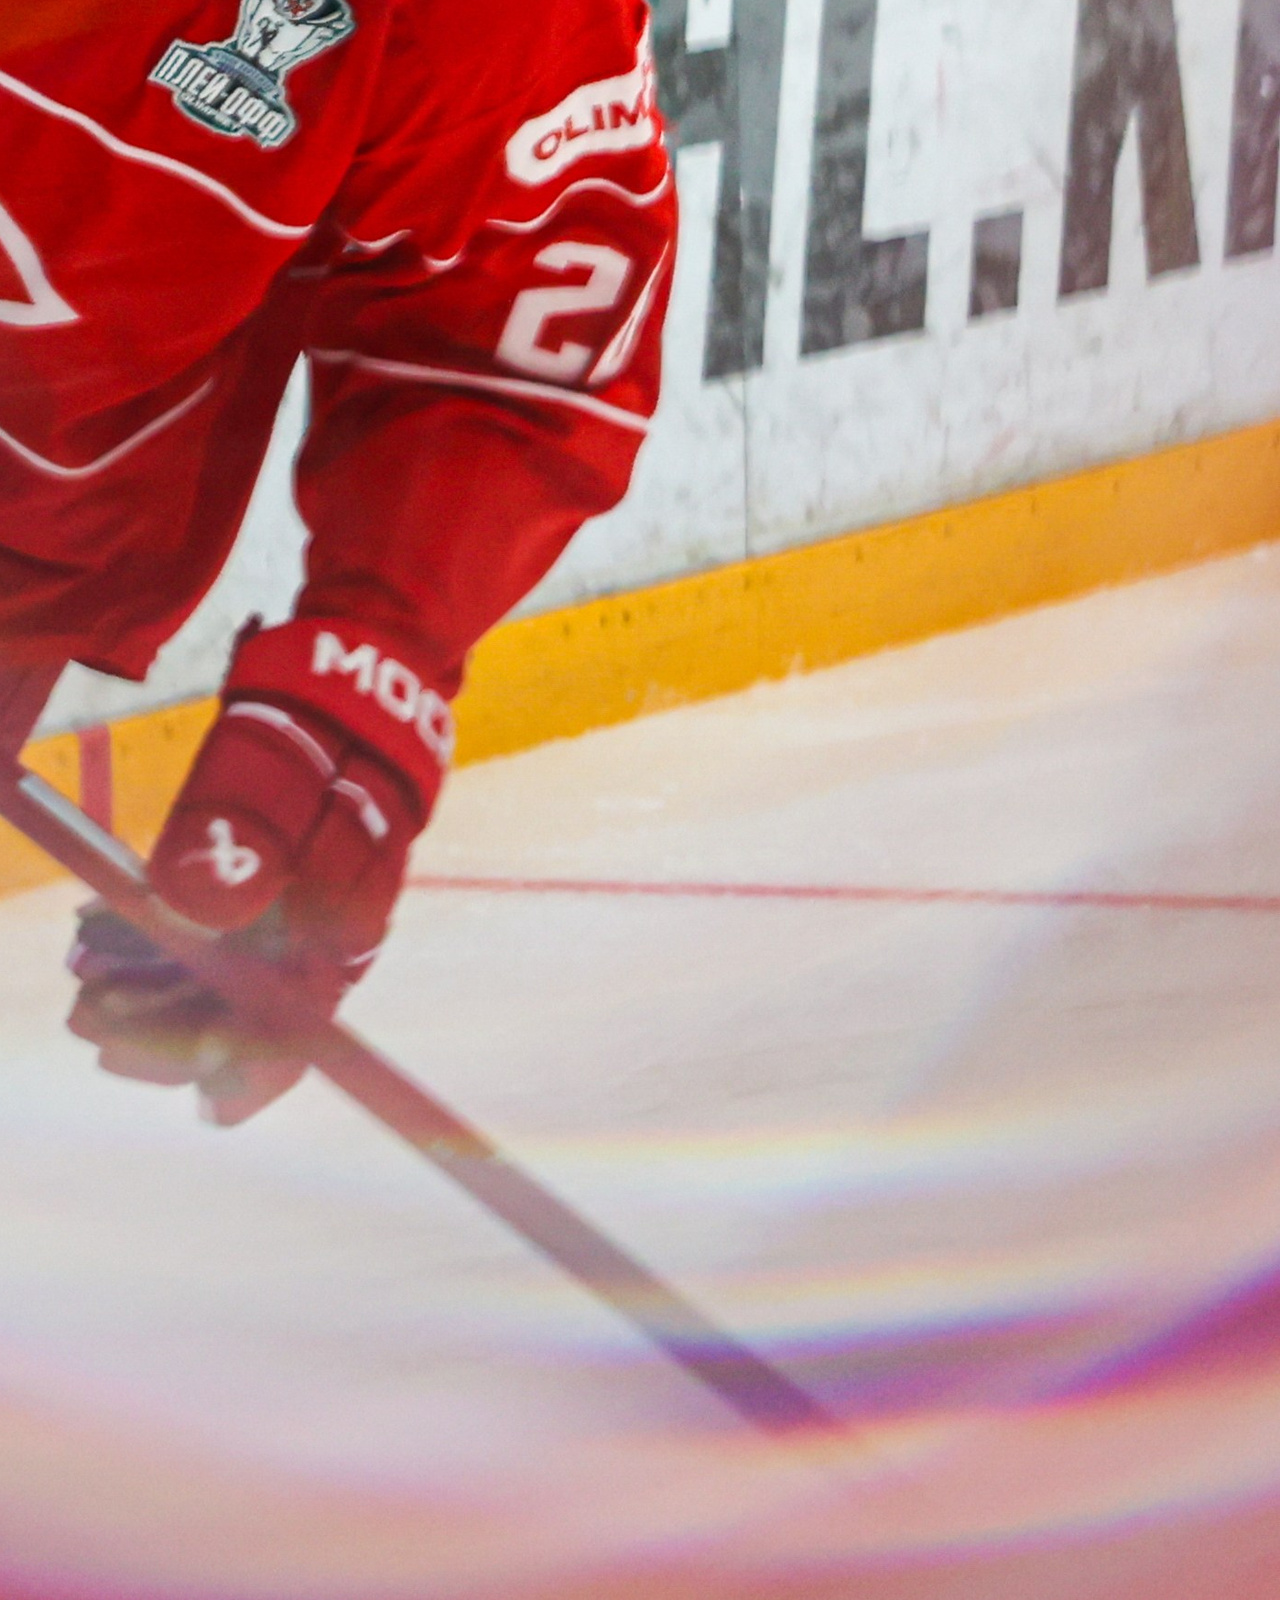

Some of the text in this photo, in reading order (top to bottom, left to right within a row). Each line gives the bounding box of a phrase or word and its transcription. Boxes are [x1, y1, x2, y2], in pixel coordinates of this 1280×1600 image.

[158, 48, 288, 140] ПЛЕЙ-ОФФ
[533, 94, 652, 160] OLIM
[494, 241, 668, 388] 2
